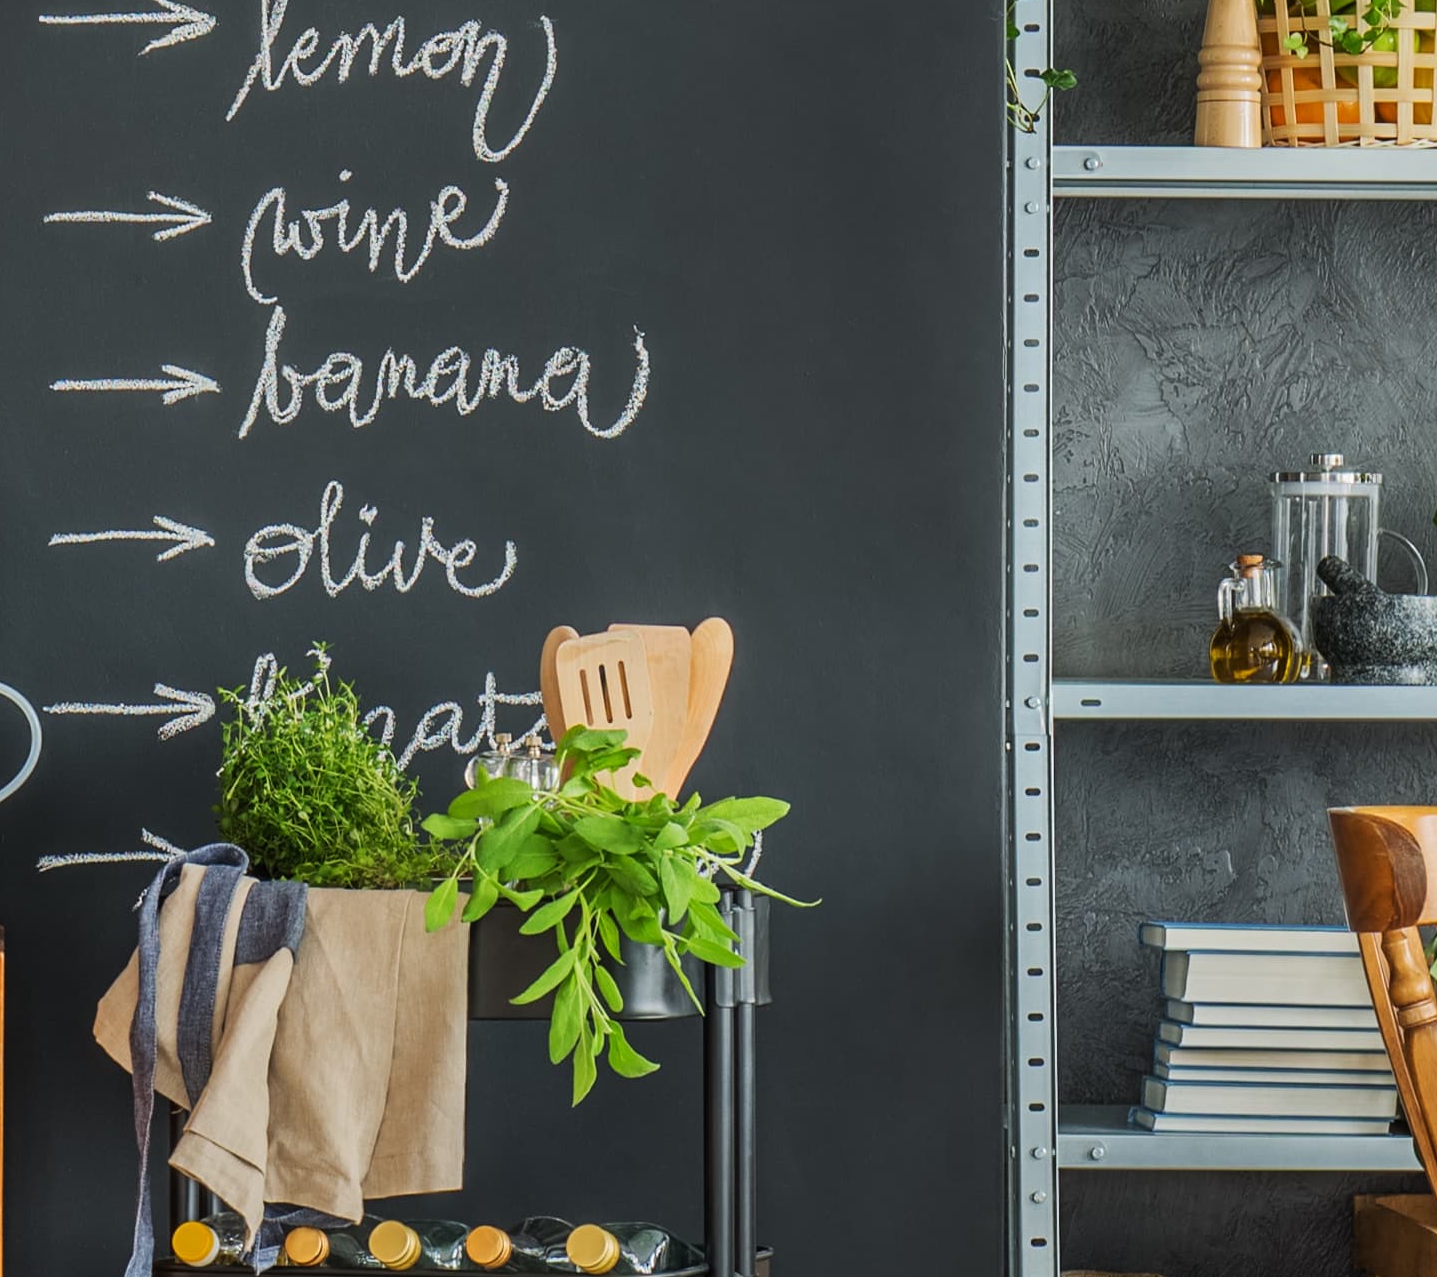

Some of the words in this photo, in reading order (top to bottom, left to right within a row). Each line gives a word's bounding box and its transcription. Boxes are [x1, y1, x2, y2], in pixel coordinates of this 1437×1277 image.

[240, 169, 510, 305] wine
[238, 305, 651, 440] banana
[243, 480, 518, 601] olive
